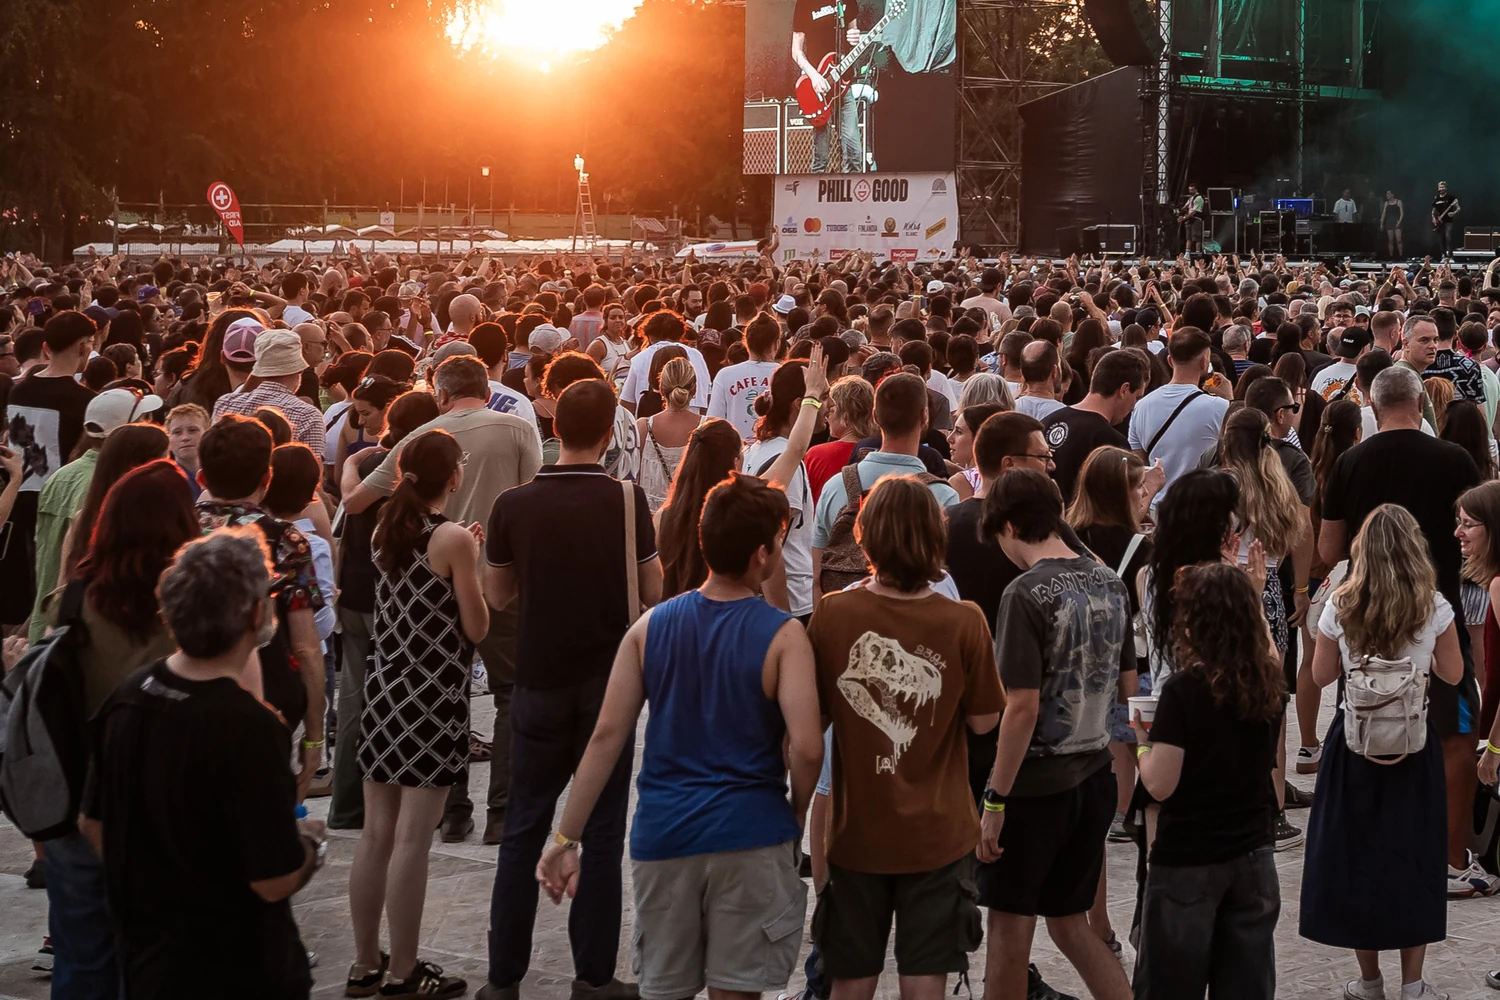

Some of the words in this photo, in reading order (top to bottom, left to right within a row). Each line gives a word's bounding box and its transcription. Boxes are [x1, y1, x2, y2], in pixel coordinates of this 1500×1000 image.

[817, 179, 853, 203] PHILL
[872, 178, 909, 203] GOOD
[826, 224, 848, 232] TUBORG
[902, 221, 922, 231] 1664
[729, 376, 758, 397] CAFE
